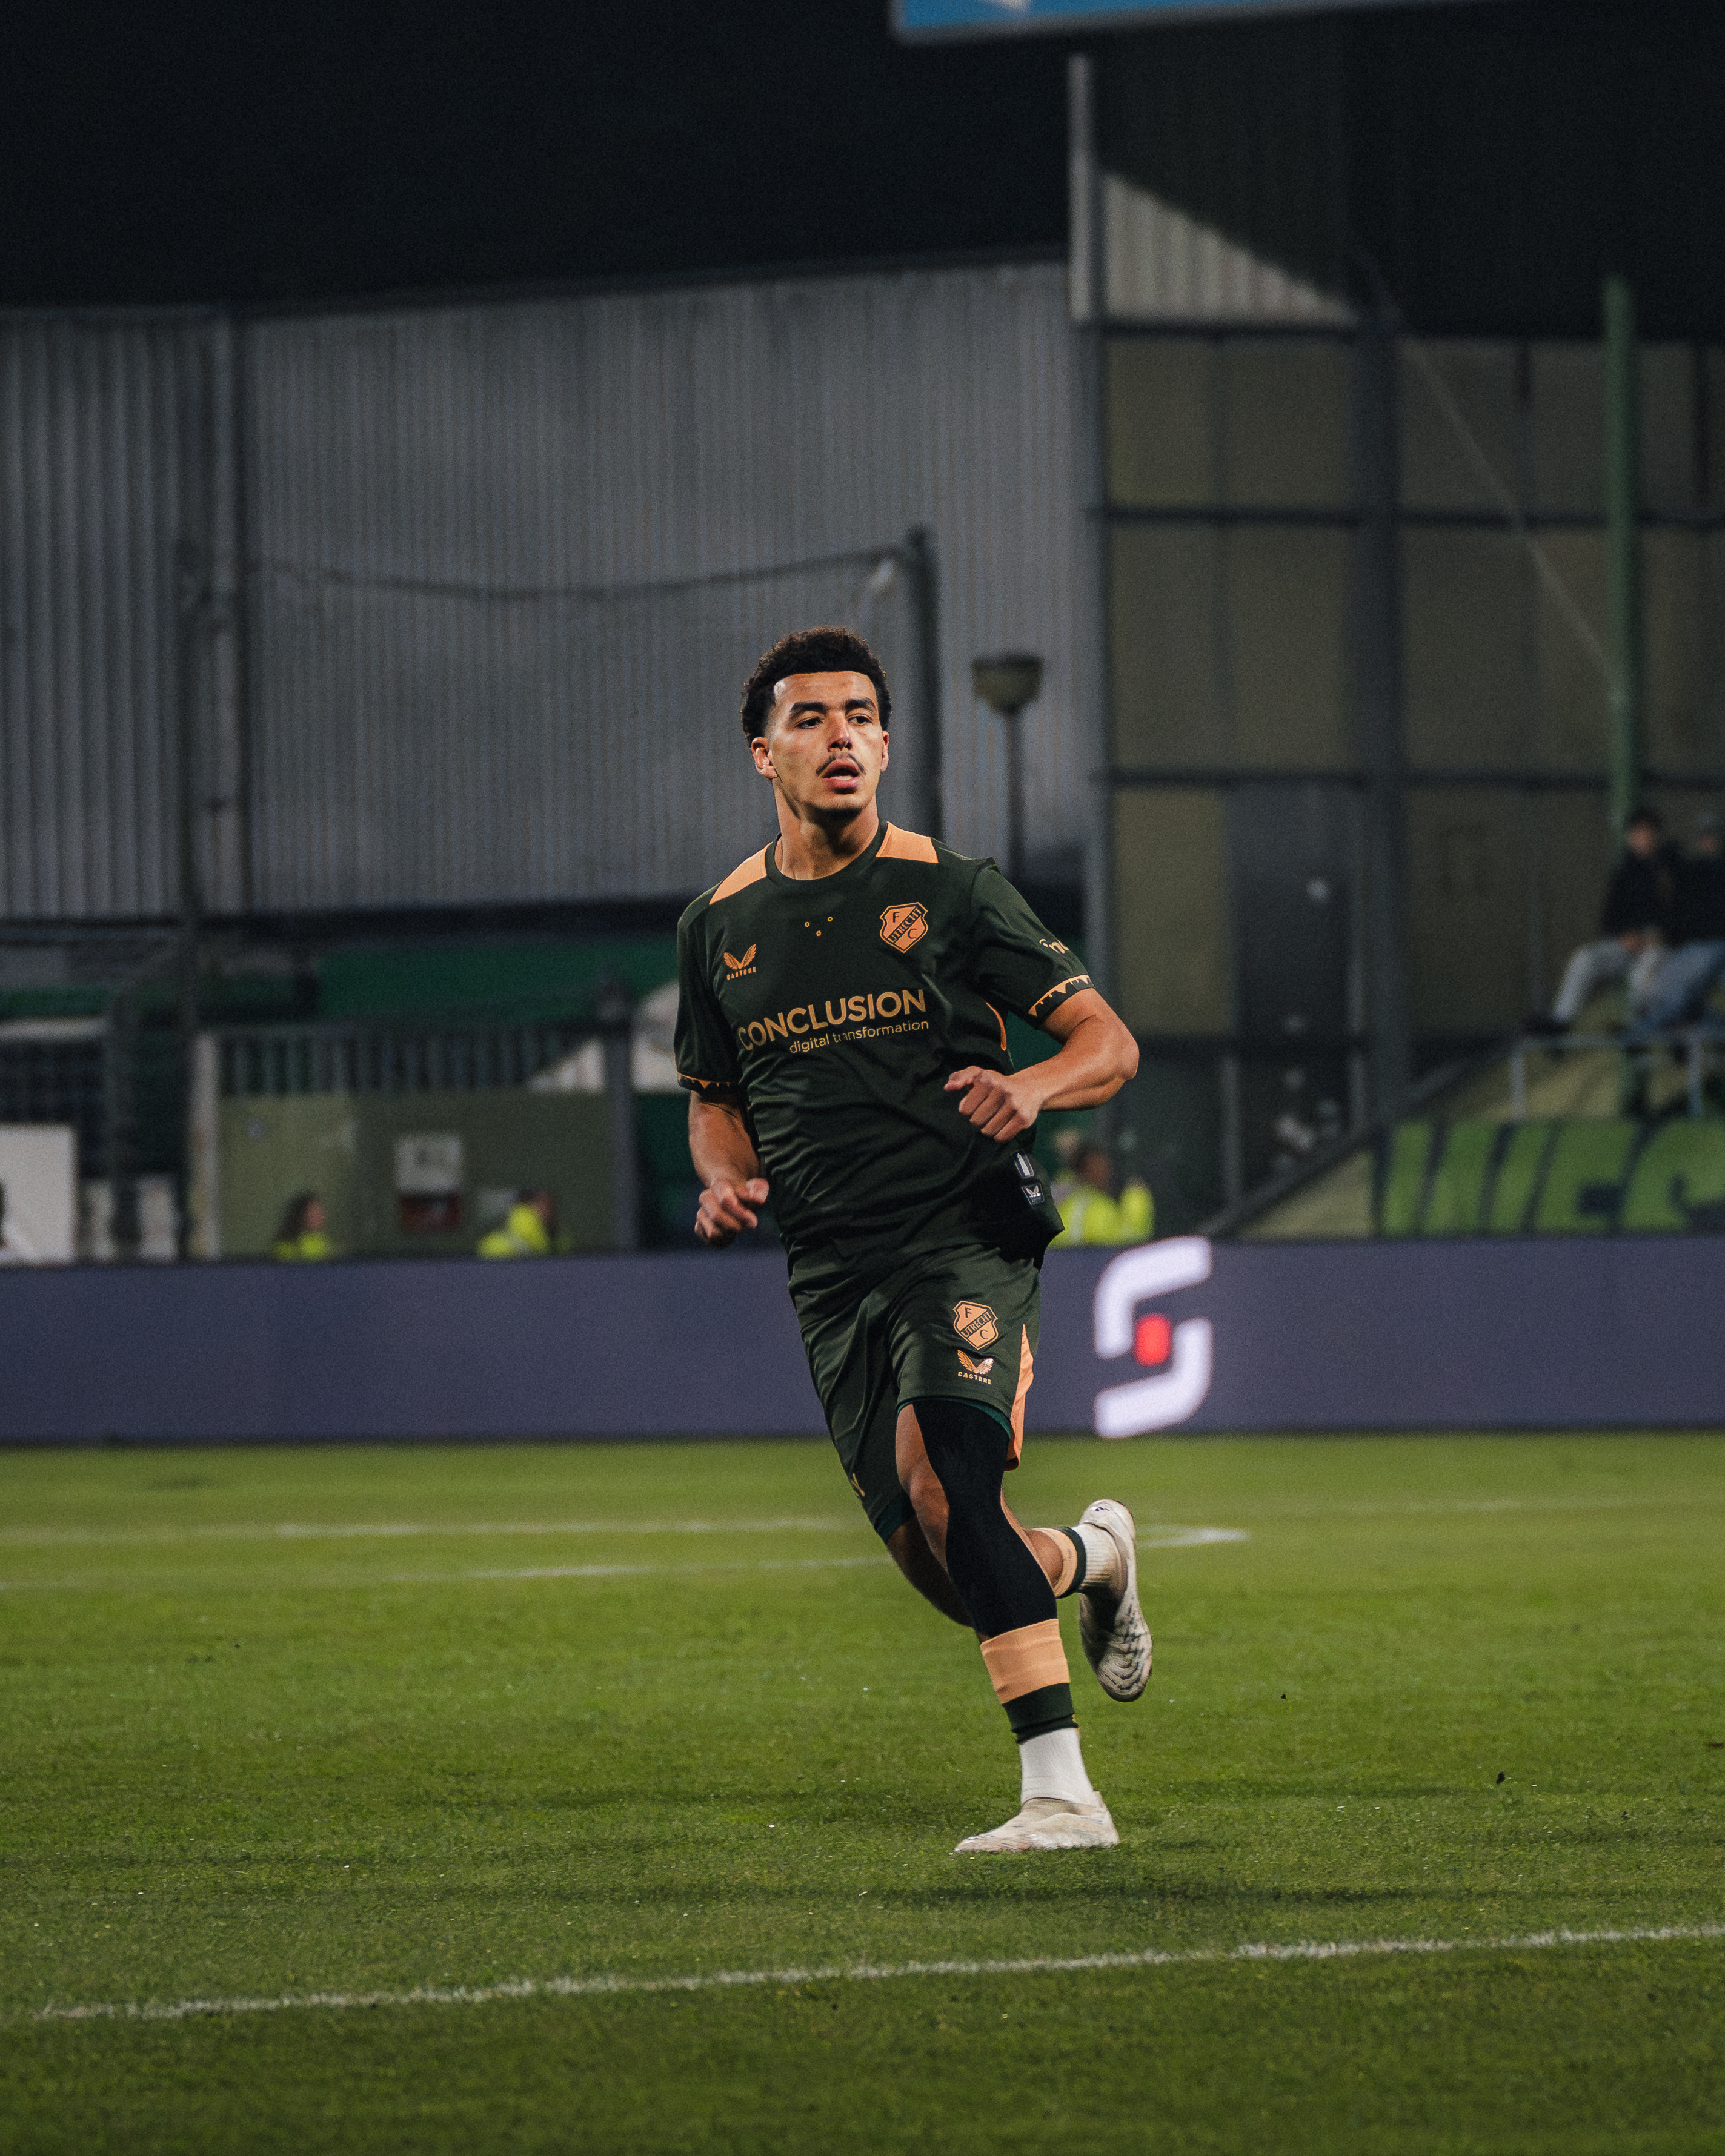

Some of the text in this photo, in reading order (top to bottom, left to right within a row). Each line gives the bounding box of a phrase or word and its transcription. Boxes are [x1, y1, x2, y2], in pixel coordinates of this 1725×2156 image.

[888, 907, 922, 943] UTRECHT
[737, 989, 926, 1050] CONCLUSION
[789, 1020, 929, 1053] digital transformation
[960, 1311, 992, 1338] UTRECHT
